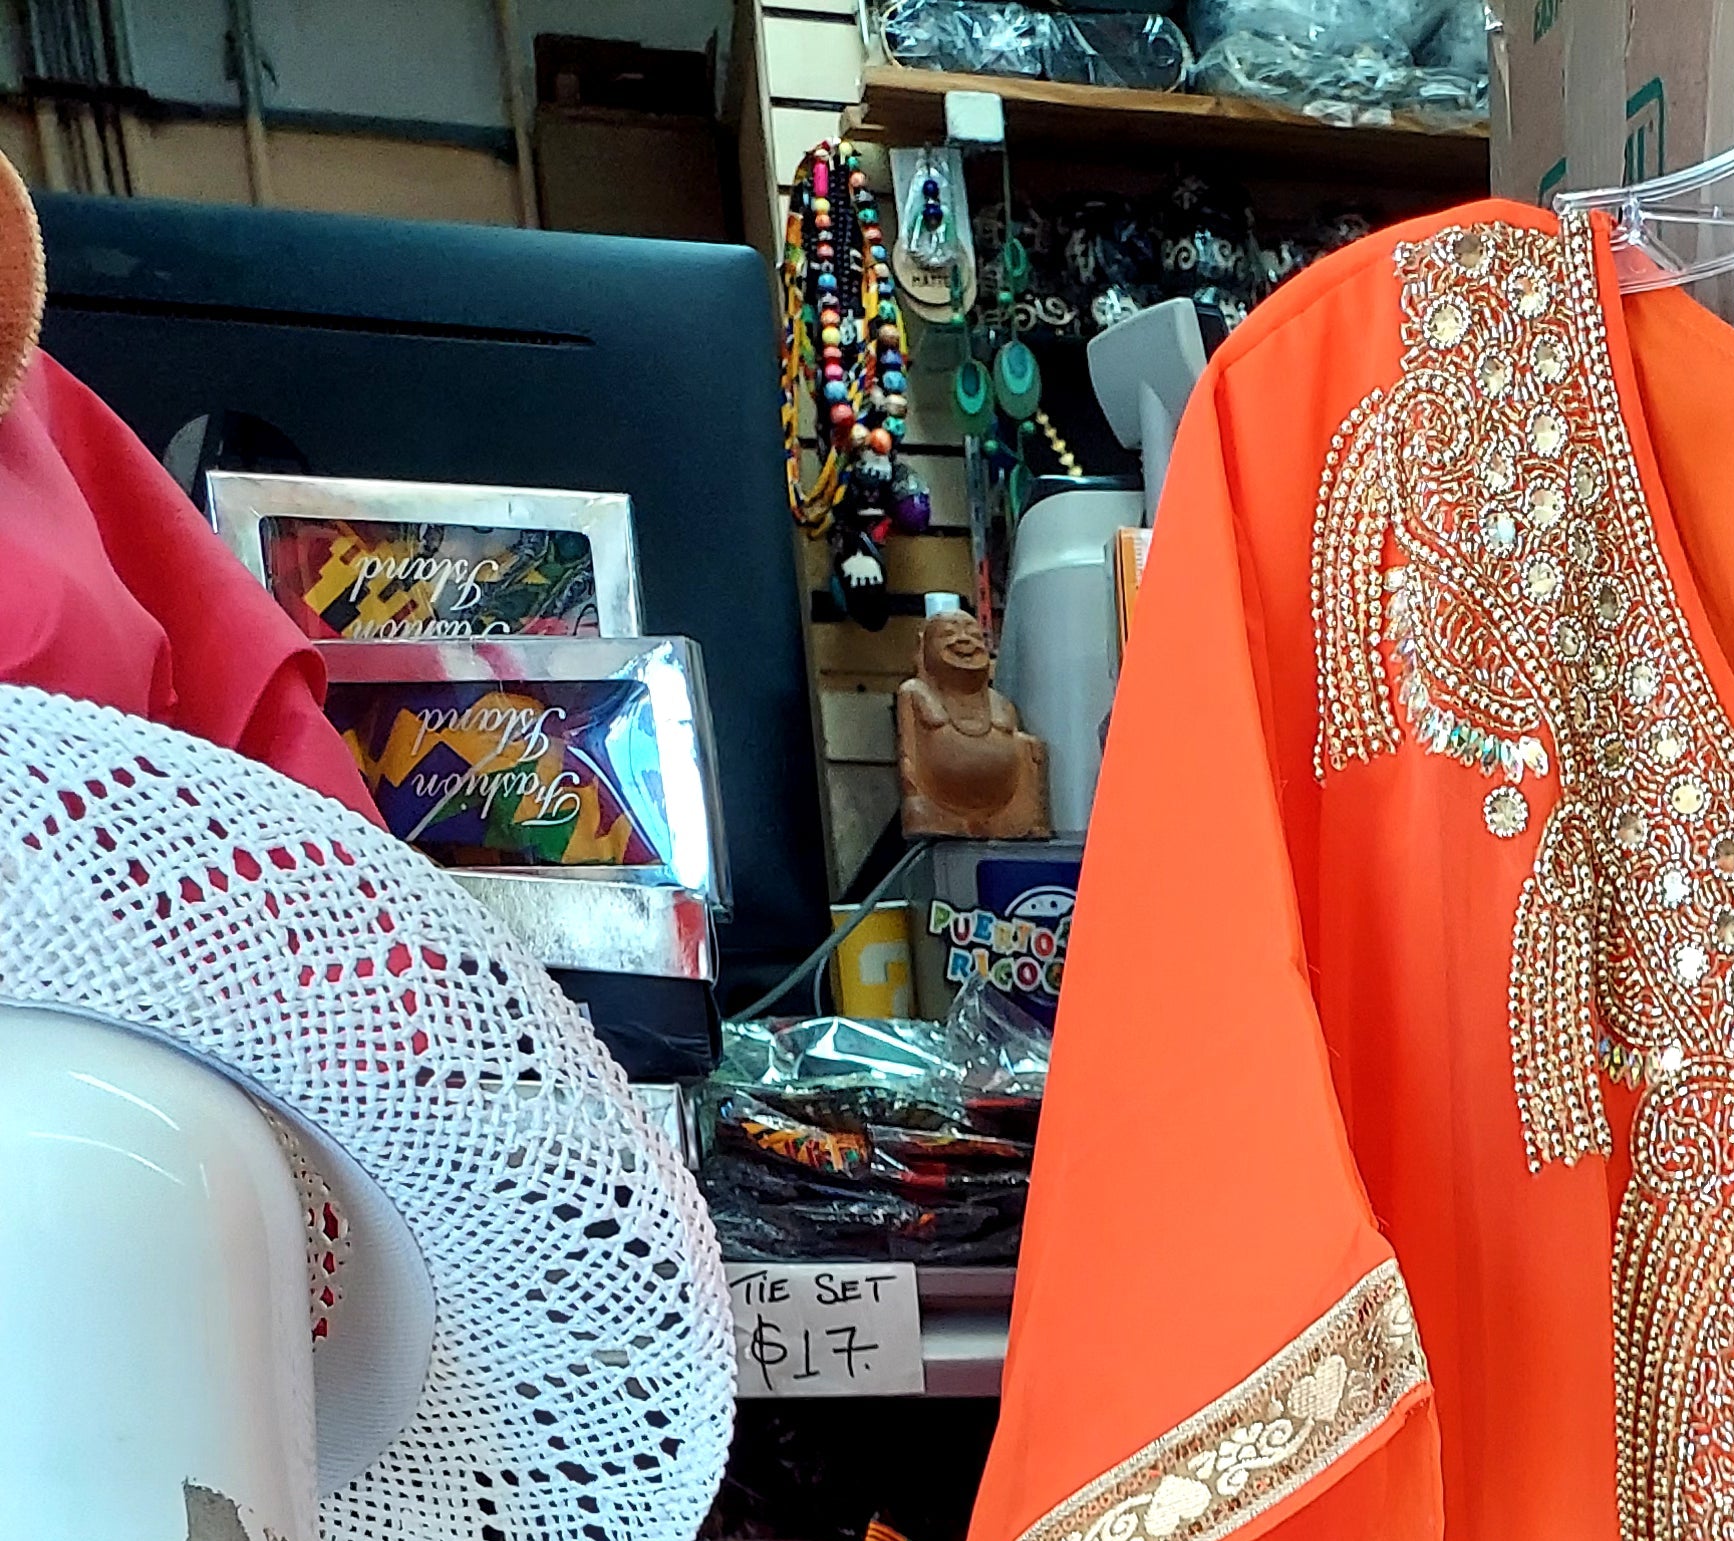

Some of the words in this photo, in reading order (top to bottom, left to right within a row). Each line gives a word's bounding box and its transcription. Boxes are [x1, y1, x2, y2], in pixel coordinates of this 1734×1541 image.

[350, 555, 499, 611] Island
[411, 705, 566, 763] Island
[410, 770, 582, 827] Fashion
[815, 1273, 897, 1305] SET
